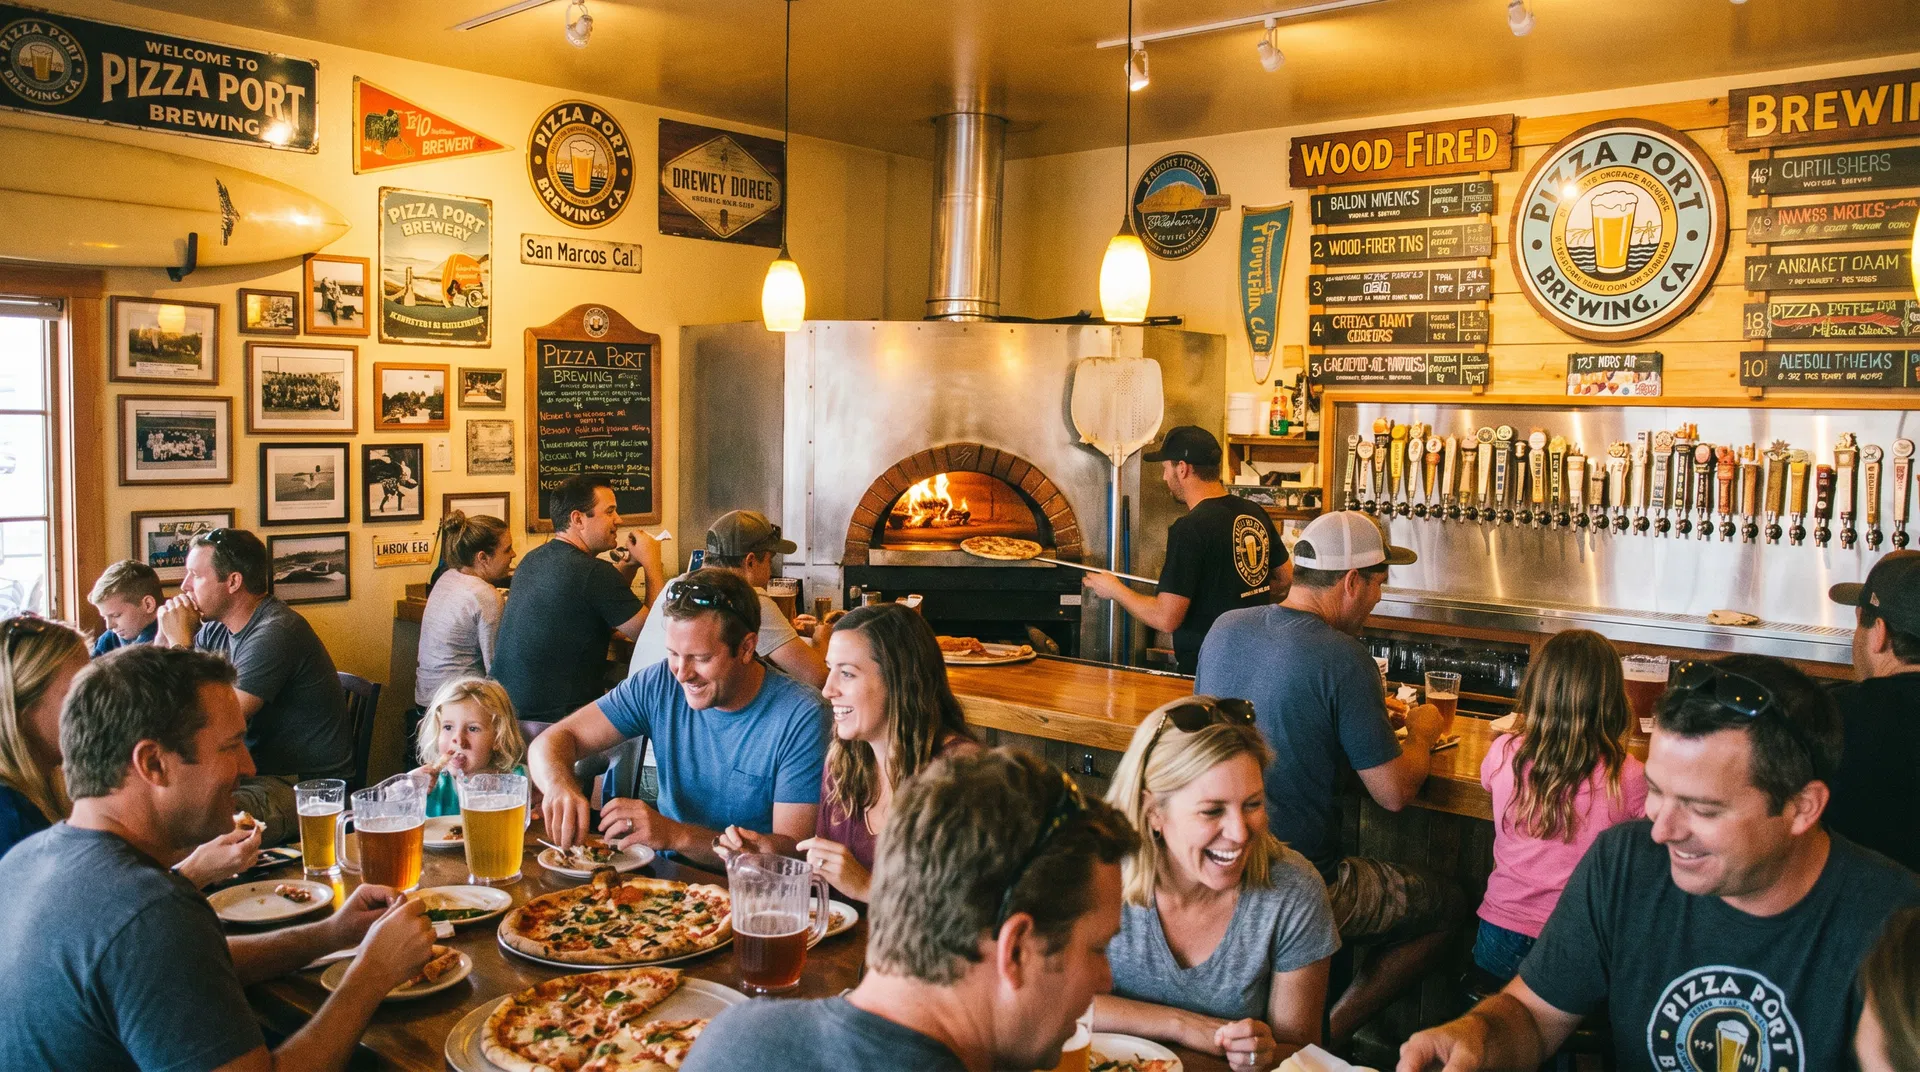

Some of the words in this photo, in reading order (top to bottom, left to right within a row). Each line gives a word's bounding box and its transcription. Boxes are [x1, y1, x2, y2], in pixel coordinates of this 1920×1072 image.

[0, 23, 43, 51] PIZZA
[145, 40, 232, 67] WELCOME
[236, 57, 259, 72] TO
[65, 79, 80, 93] CA
[101, 52, 209, 103] PIZZA
[219, 73, 305, 129] PORT
[149, 103, 260, 136] BREWING
[535, 106, 586, 148] PIZZA
[591, 111, 629, 159] PORT
[422, 136, 476, 155] BREWERY
[1300, 138, 1394, 177] WOOD
[1405, 127, 1498, 168] FIRED
[672, 167, 727, 195] DREWEY
[731, 176, 773, 202] DORGE
[1530, 141, 1618, 223] PIZZA
[1630, 141, 1704, 212] PORT
[609, 189, 626, 210] CA
[388, 202, 439, 224] PIZZA
[442, 205, 486, 234] PORT
[401, 220, 472, 242] BREWERY
[526, 239, 553, 260] San
[558, 242, 607, 265] Marcos
[613, 247, 638, 267] Cal.
[1398, 235, 1424, 253] TNS
[1748, 264, 1767, 283] 17
[1536, 265, 1659, 320] BREWING,
[1660, 261, 1694, 293] CA
[1312, 321, 1322, 337] 4
[1745, 312, 1764, 329] 18
[544, 344, 597, 366] PIZZA
[606, 346, 646, 368] PORT
[1743, 359, 1764, 378] 10
[553, 370, 612, 383] BREWING
[1661, 975, 1741, 1022] PIZZA
[1750, 983, 1795, 1055] PORT
